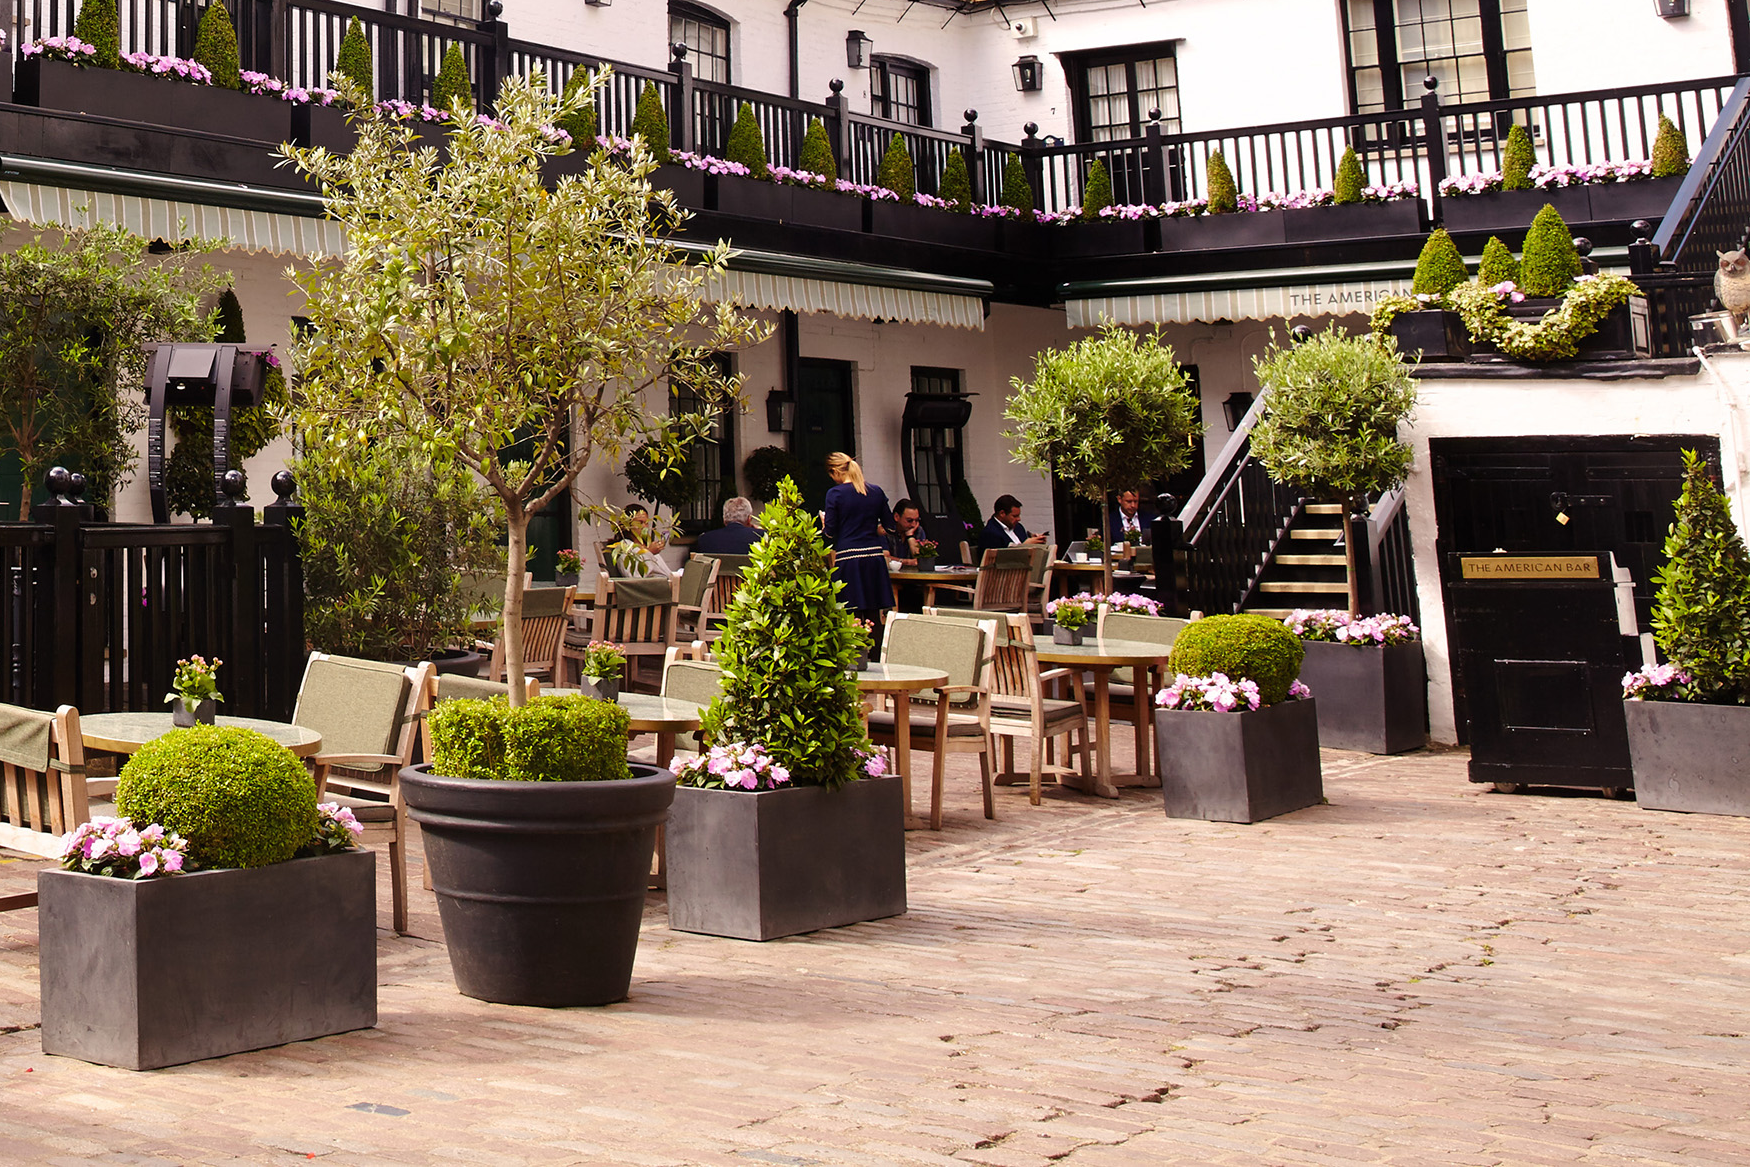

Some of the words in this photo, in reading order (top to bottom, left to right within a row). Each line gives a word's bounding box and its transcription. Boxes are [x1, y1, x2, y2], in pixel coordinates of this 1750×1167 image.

[1050, 107, 1056, 115] 7
[1290, 293, 1322, 306] THE
[1468, 563, 1491, 572] THE
[1494, 563, 1562, 573] AMERICAN
[1566, 562, 1591, 572] BAR
